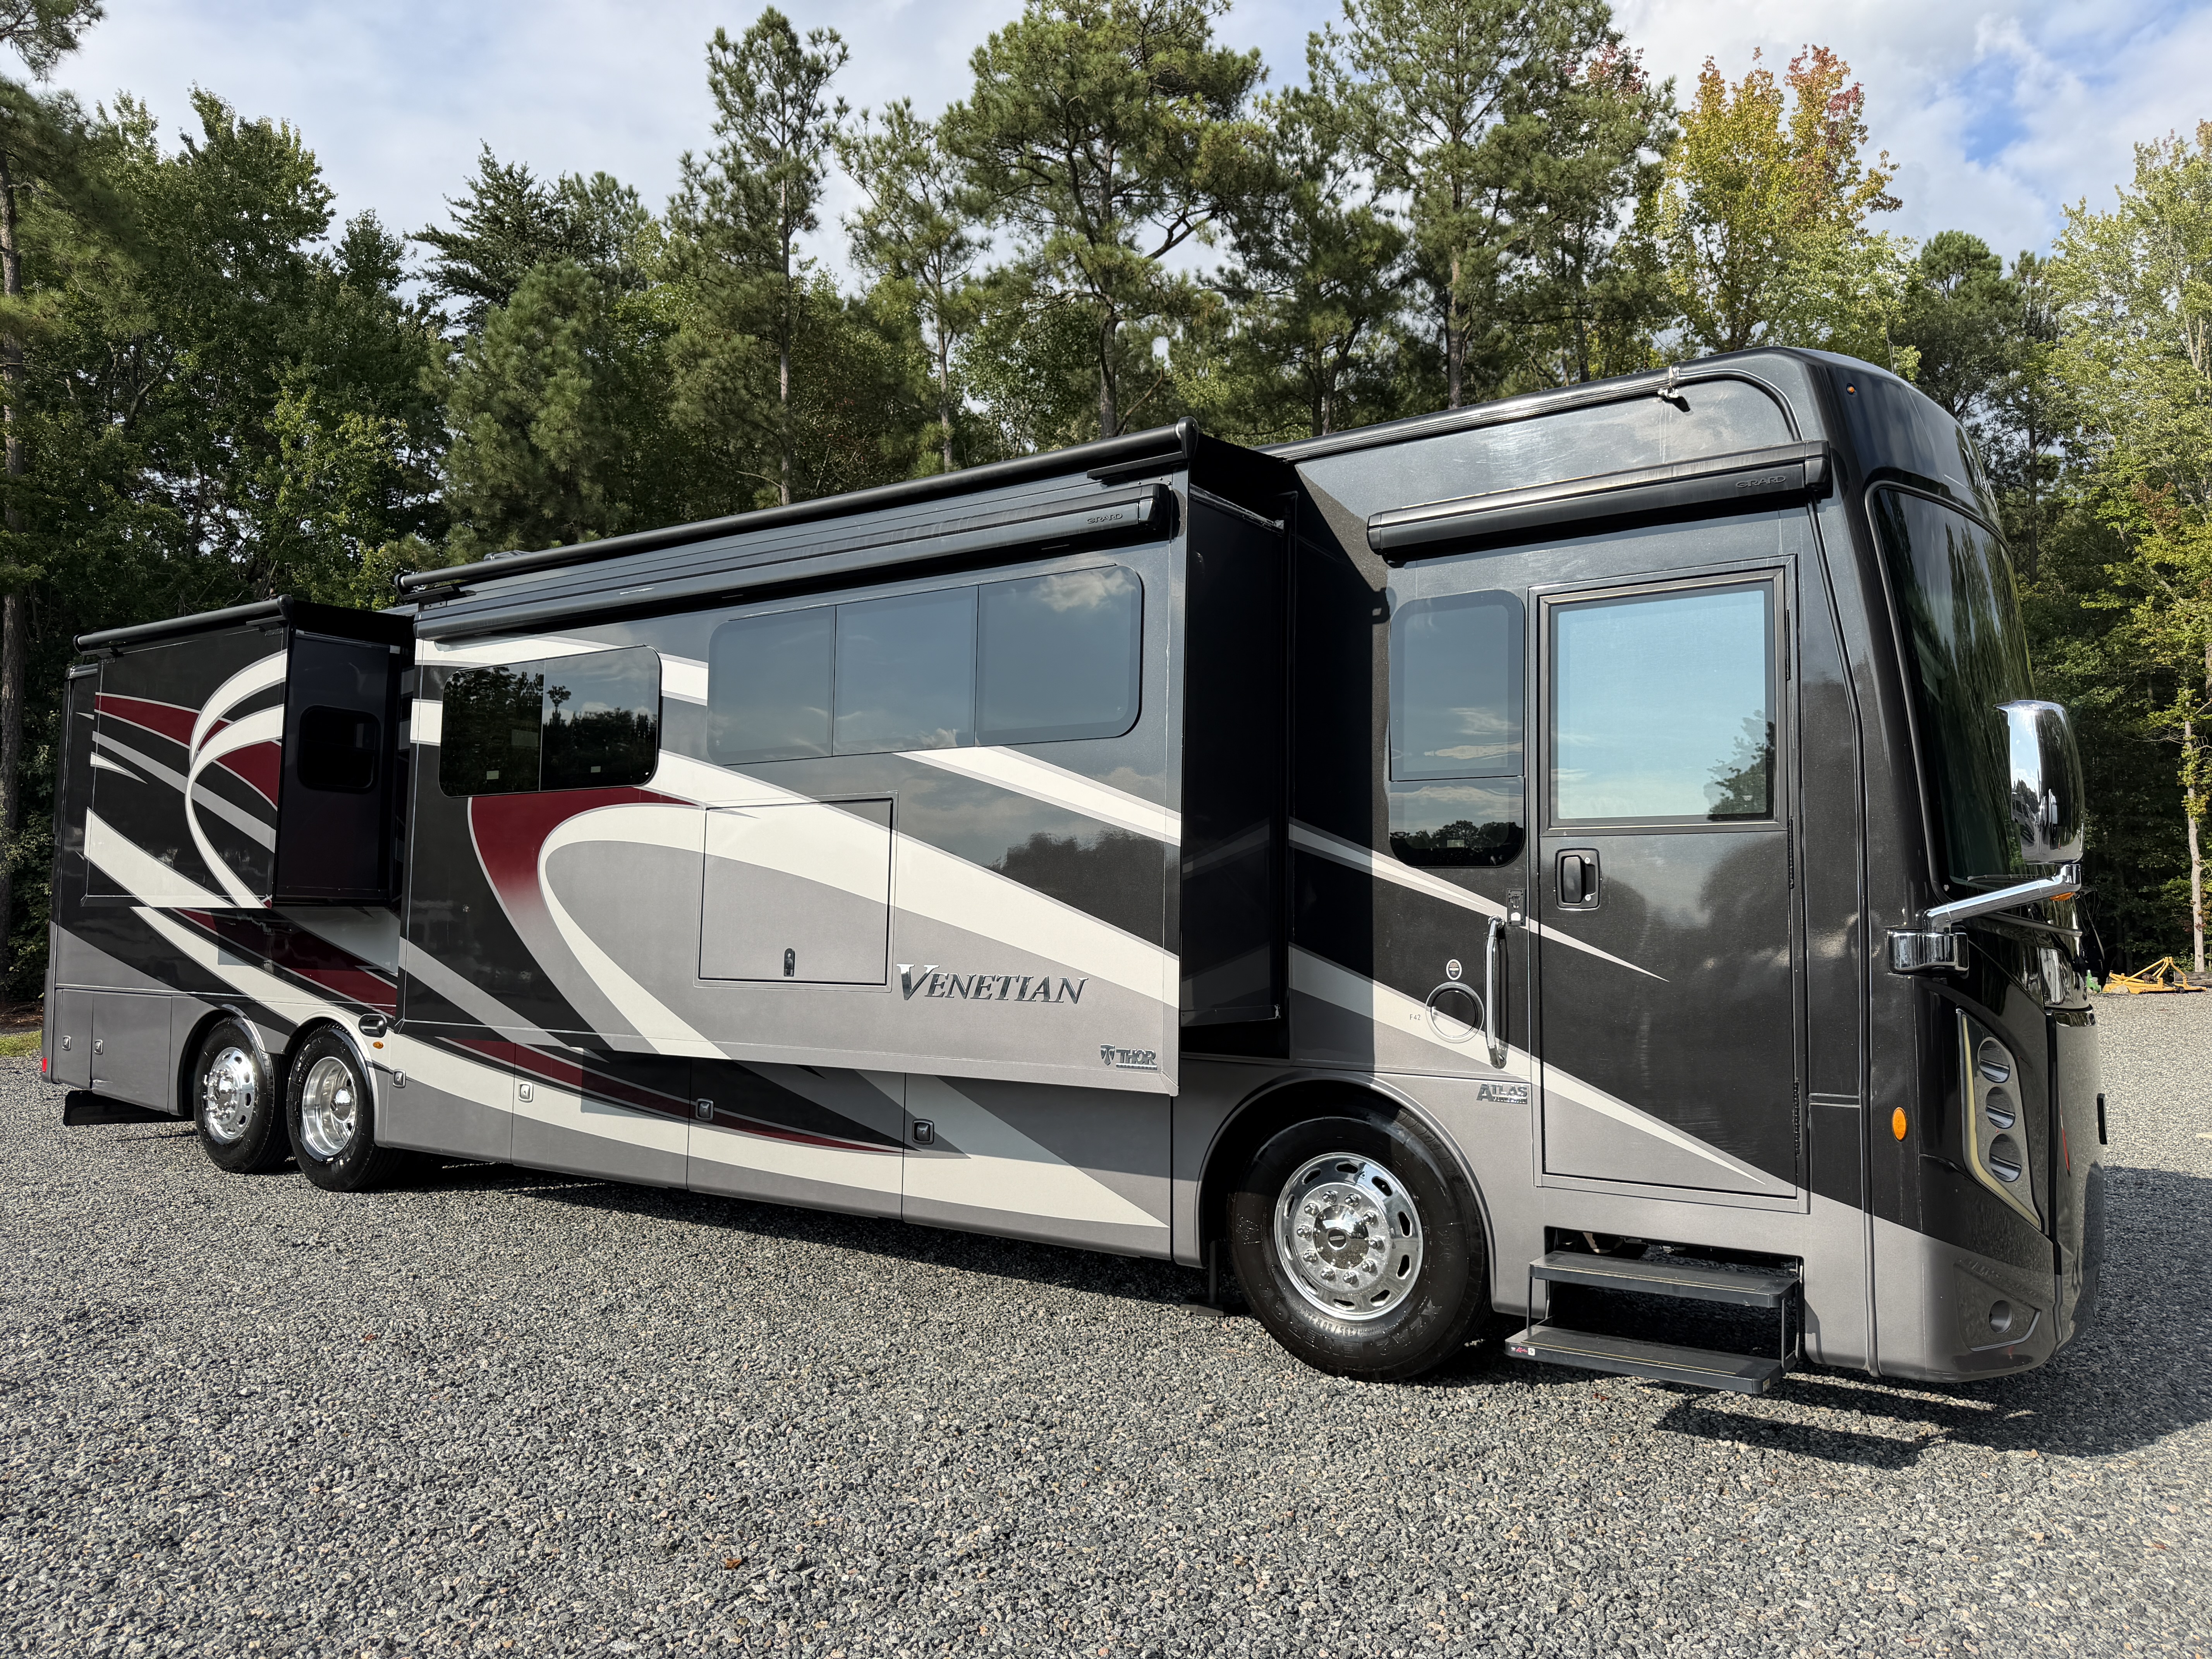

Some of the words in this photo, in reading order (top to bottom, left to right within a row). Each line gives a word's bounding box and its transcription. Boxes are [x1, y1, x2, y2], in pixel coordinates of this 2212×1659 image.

[896, 964, 1088, 1003] VENETIAN
[1116, 1049, 1157, 1065] THOR
[1476, 1083, 1527, 1102] ATLAS
[1259, 1288, 1360, 1358] ENERGY
[1376, 1298, 1442, 1355] XZA2
